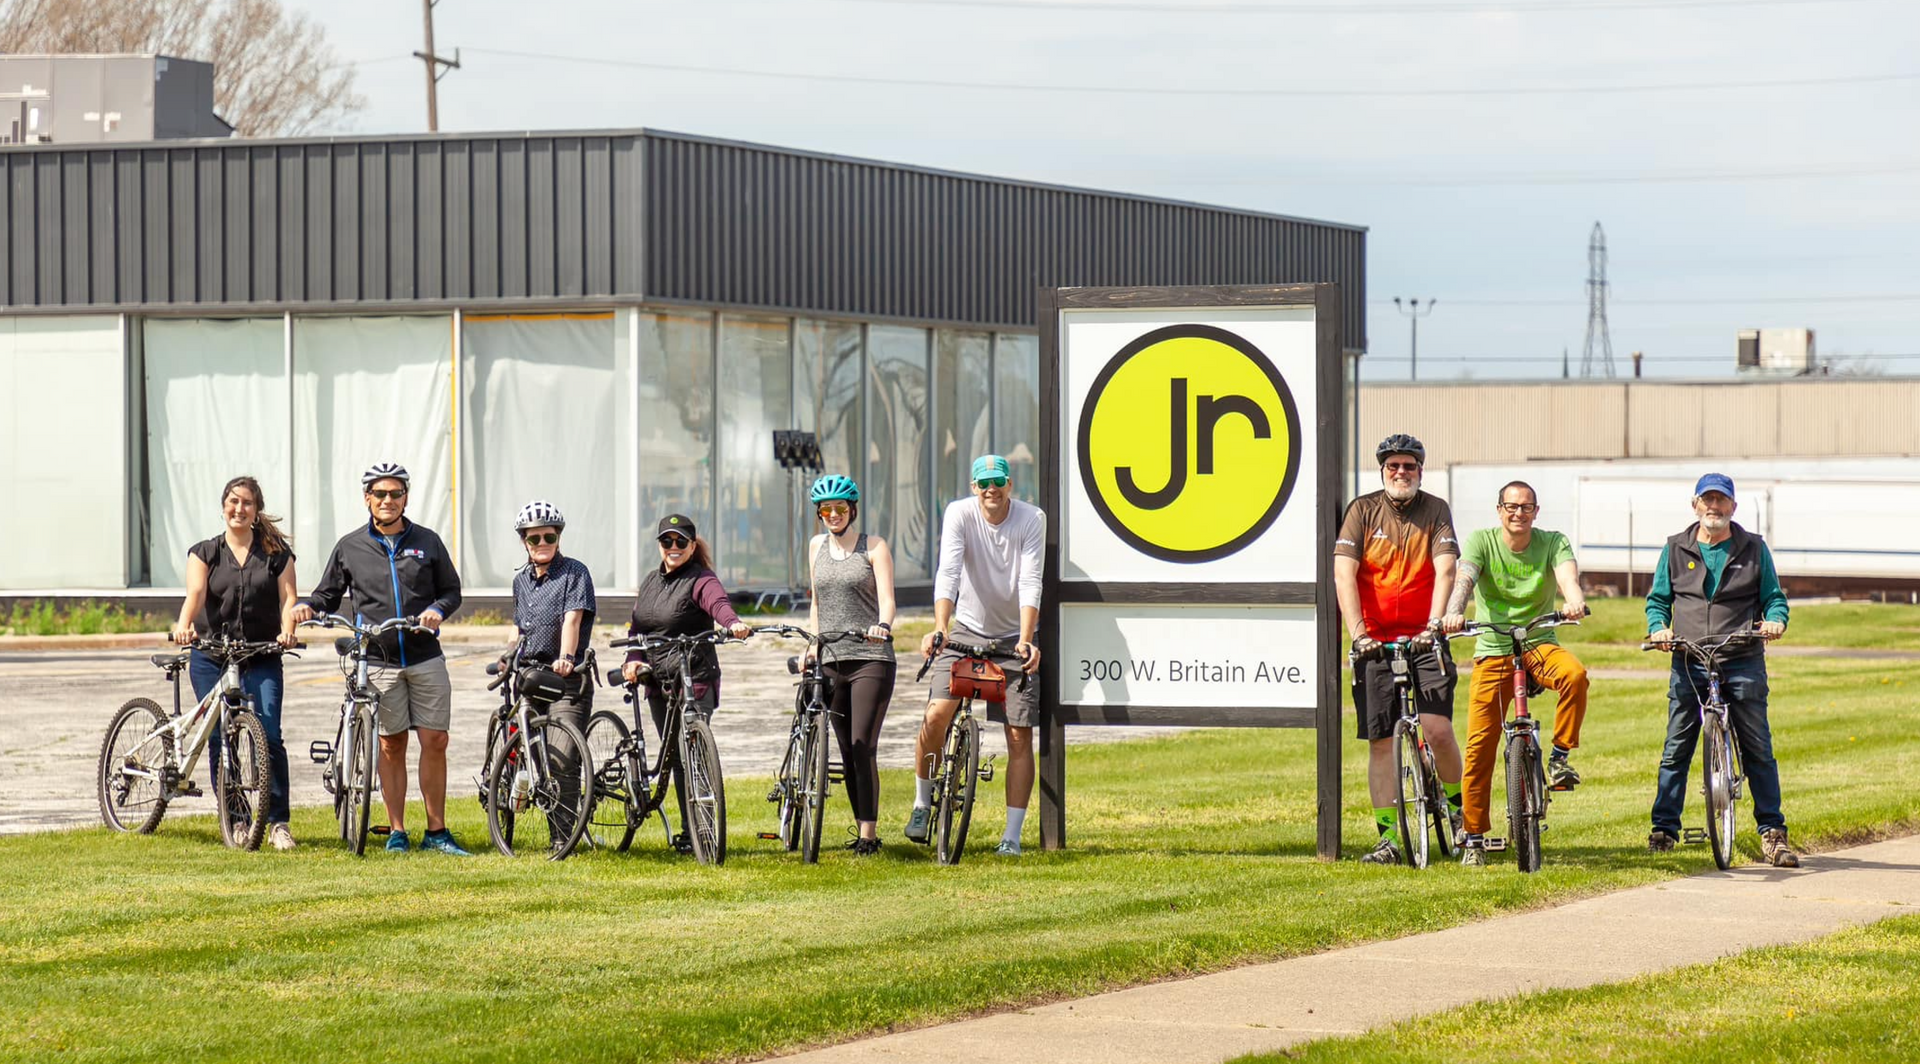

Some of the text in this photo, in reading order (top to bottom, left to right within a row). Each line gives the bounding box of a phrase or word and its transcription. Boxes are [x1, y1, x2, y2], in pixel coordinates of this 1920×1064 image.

[1115, 377, 1272, 511] Jr
[1079, 659, 1306, 684] 300 W. Britain Ave.
